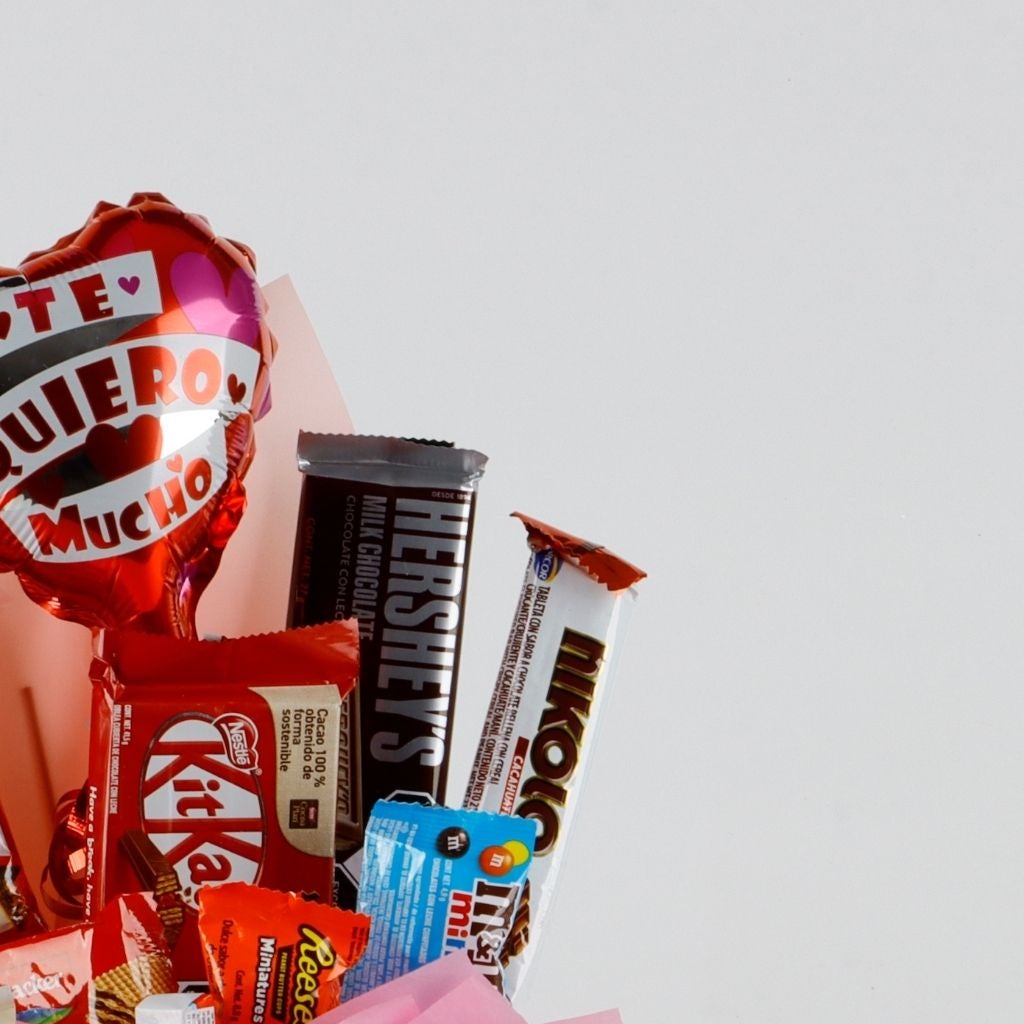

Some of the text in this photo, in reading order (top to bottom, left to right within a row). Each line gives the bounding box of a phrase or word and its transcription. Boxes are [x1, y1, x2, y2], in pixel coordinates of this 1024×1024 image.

[14, 273, 114, 333] TE
[29, 458, 212, 556] MUCHO
[339, 494, 356, 566] CHOCOLATE
[336, 567, 348, 595] CON
[351, 494, 387, 641] MILK CHOCOLATE
[532, 584, 550, 617] TABLETA
[370, 498, 471, 767] HERSHEY'S
[528, 617, 541, 633] CON
[522, 633, 537, 659] SABOR
[278, 708, 293, 771] sostenible
[291, 708, 304, 745] forma
[302, 708, 317, 779] obtenido de
[313, 708, 328, 787] Cacao 100 %
[478, 738, 496, 782] CONTENIDO
[110, 756, 119, 785] CHOCOLATE
[88, 786, 97, 821] Have
[109, 798, 117, 813] LECHE
[110, 786, 118, 797] CON
[472, 781, 486, 801] NETO
[88, 823, 94, 832] a
[447, 836, 459, 850] m
[490, 853, 505, 867] m
[84, 884, 93, 915] have
[10, 971, 64, 1002] acker
[253, 937, 276, 1024] Miniatures
